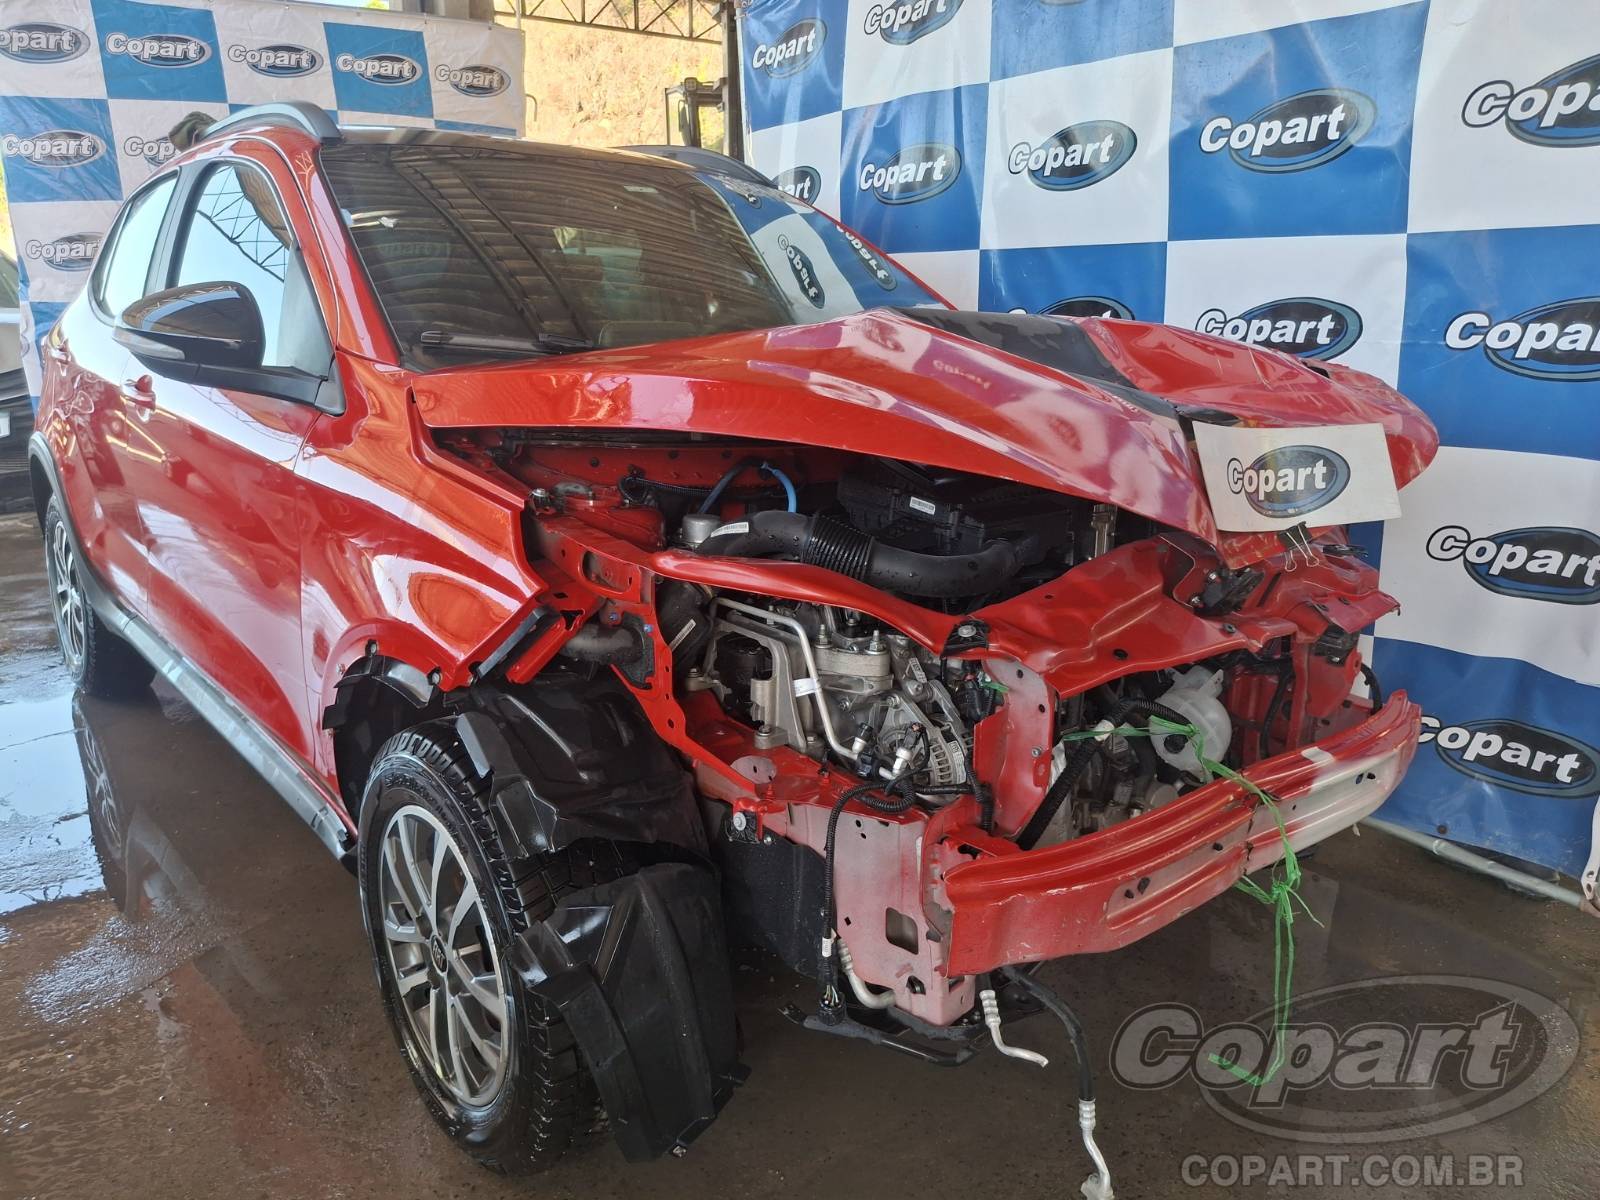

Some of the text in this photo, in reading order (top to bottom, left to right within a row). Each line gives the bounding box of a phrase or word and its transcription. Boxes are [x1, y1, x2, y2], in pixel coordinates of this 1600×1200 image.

[0, 30, 74, 53] opart
[106, 33, 200, 60] Copart
[228, 44, 313, 69] Copart
[752, 27, 816, 69] Copart
[336, 53, 413, 78] Copart
[435, 64, 502, 89] Copart
[1461, 79, 1600, 130] Cop
[3, 134, 93, 161] Copart
[124, 136, 175, 158] Cop
[1199, 103, 1345, 157] Copart
[859, 153, 947, 192] Copart
[1008, 133, 1114, 176] Copart
[25, 239, 100, 265] Copar
[1195, 308, 1335, 345] Copart
[1444, 311, 1600, 360] Copa
[1227, 457, 1327, 501] Copart
[1426, 525, 1600, 587] Copart
